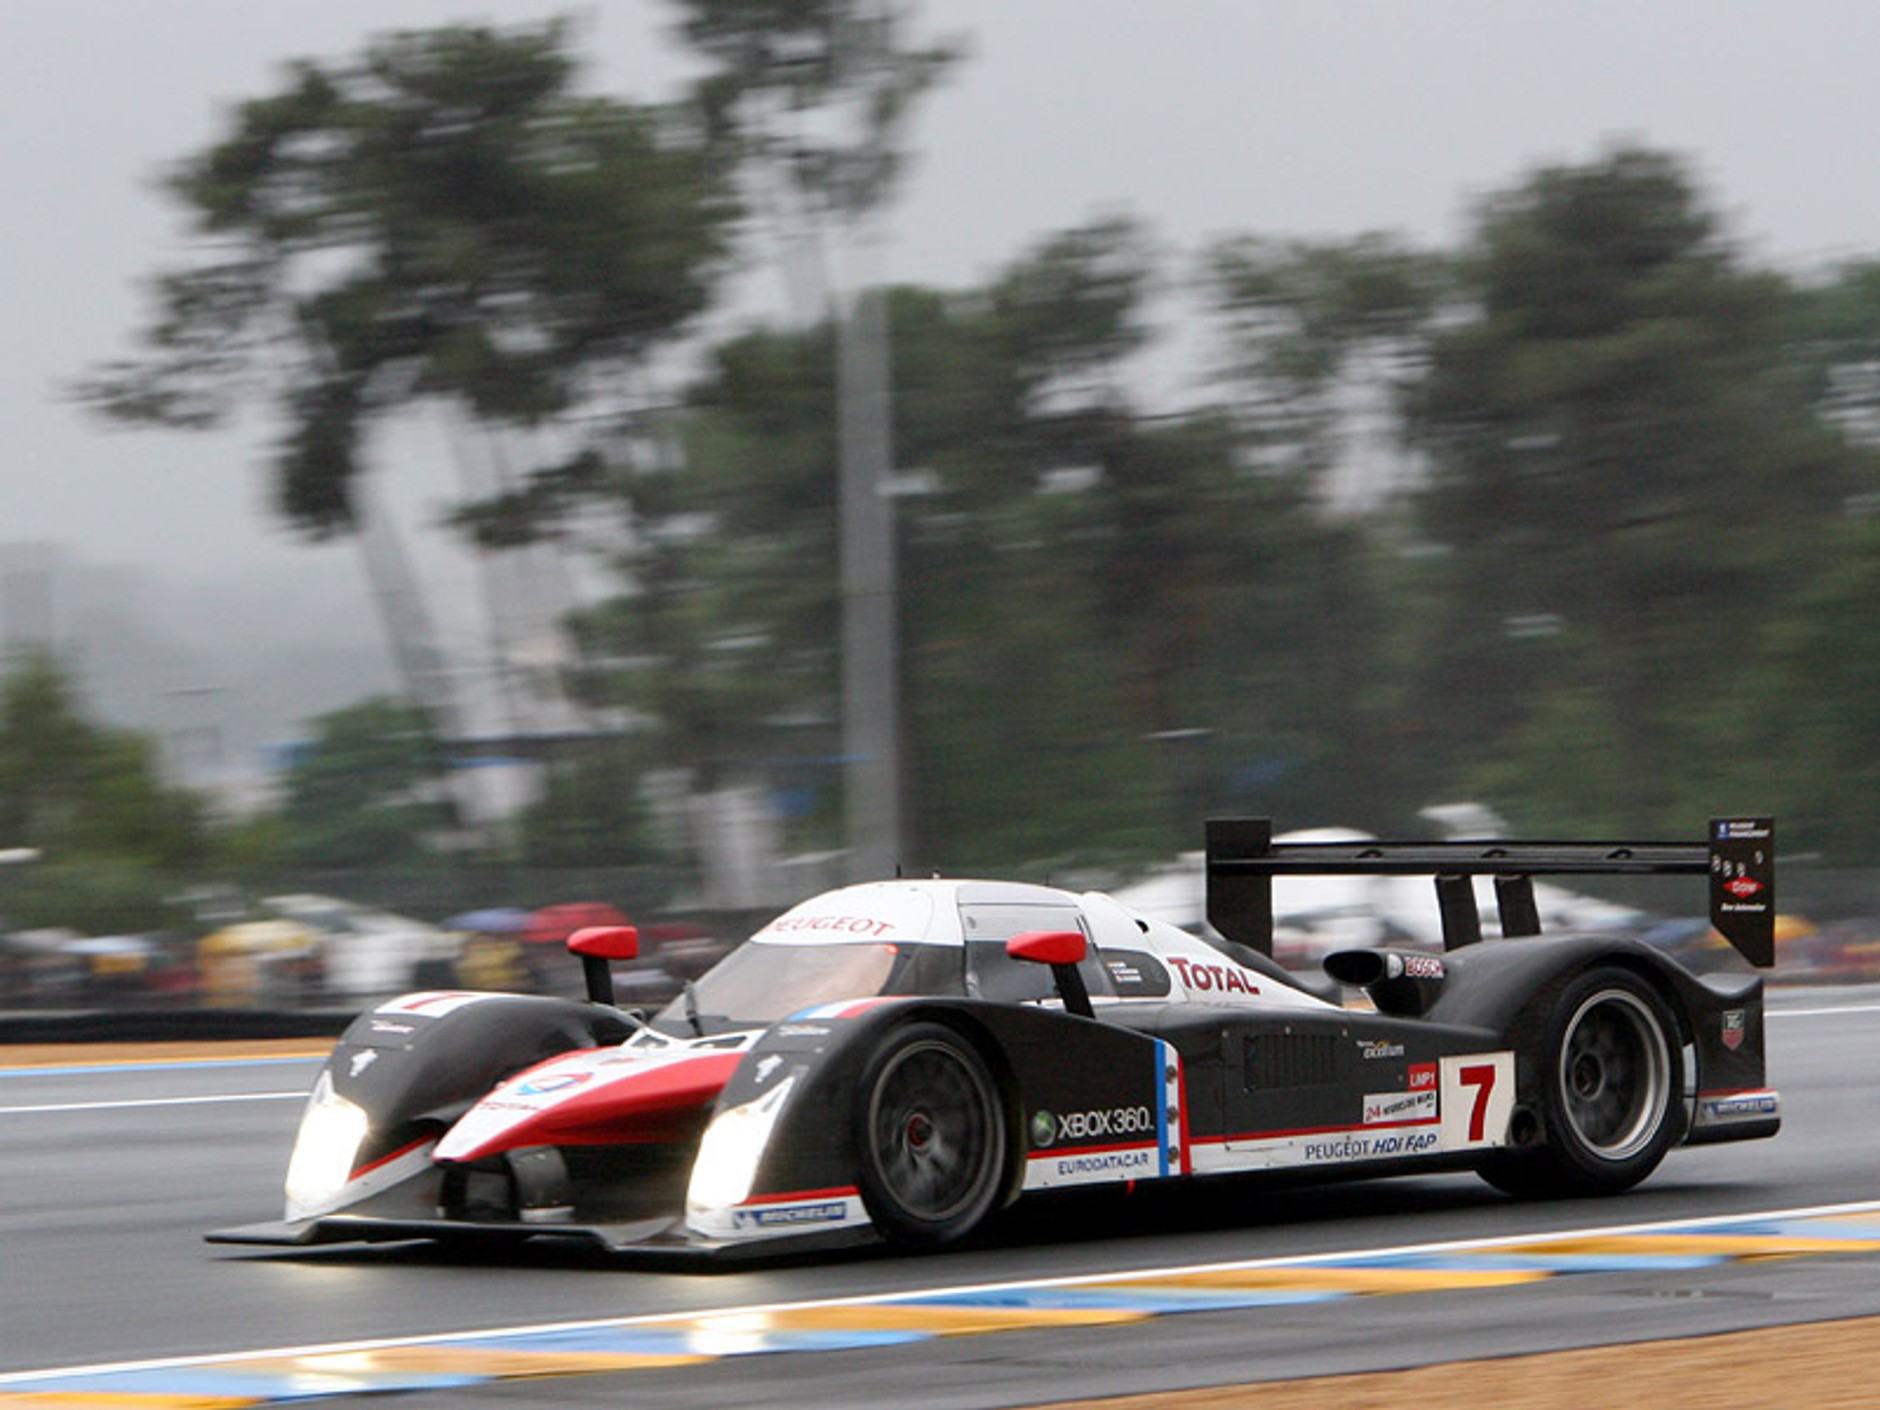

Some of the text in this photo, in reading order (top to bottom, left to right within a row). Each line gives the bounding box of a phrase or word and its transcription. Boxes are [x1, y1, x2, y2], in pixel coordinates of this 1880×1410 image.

[1365, 1104, 1382, 1122] 24
[1459, 1064, 1496, 1142] 7
[1304, 1139, 1370, 1160] PEUGEOT
[1404, 1133, 1438, 1152] FAP
[1057, 1151, 1149, 1176] EURODATACAR
